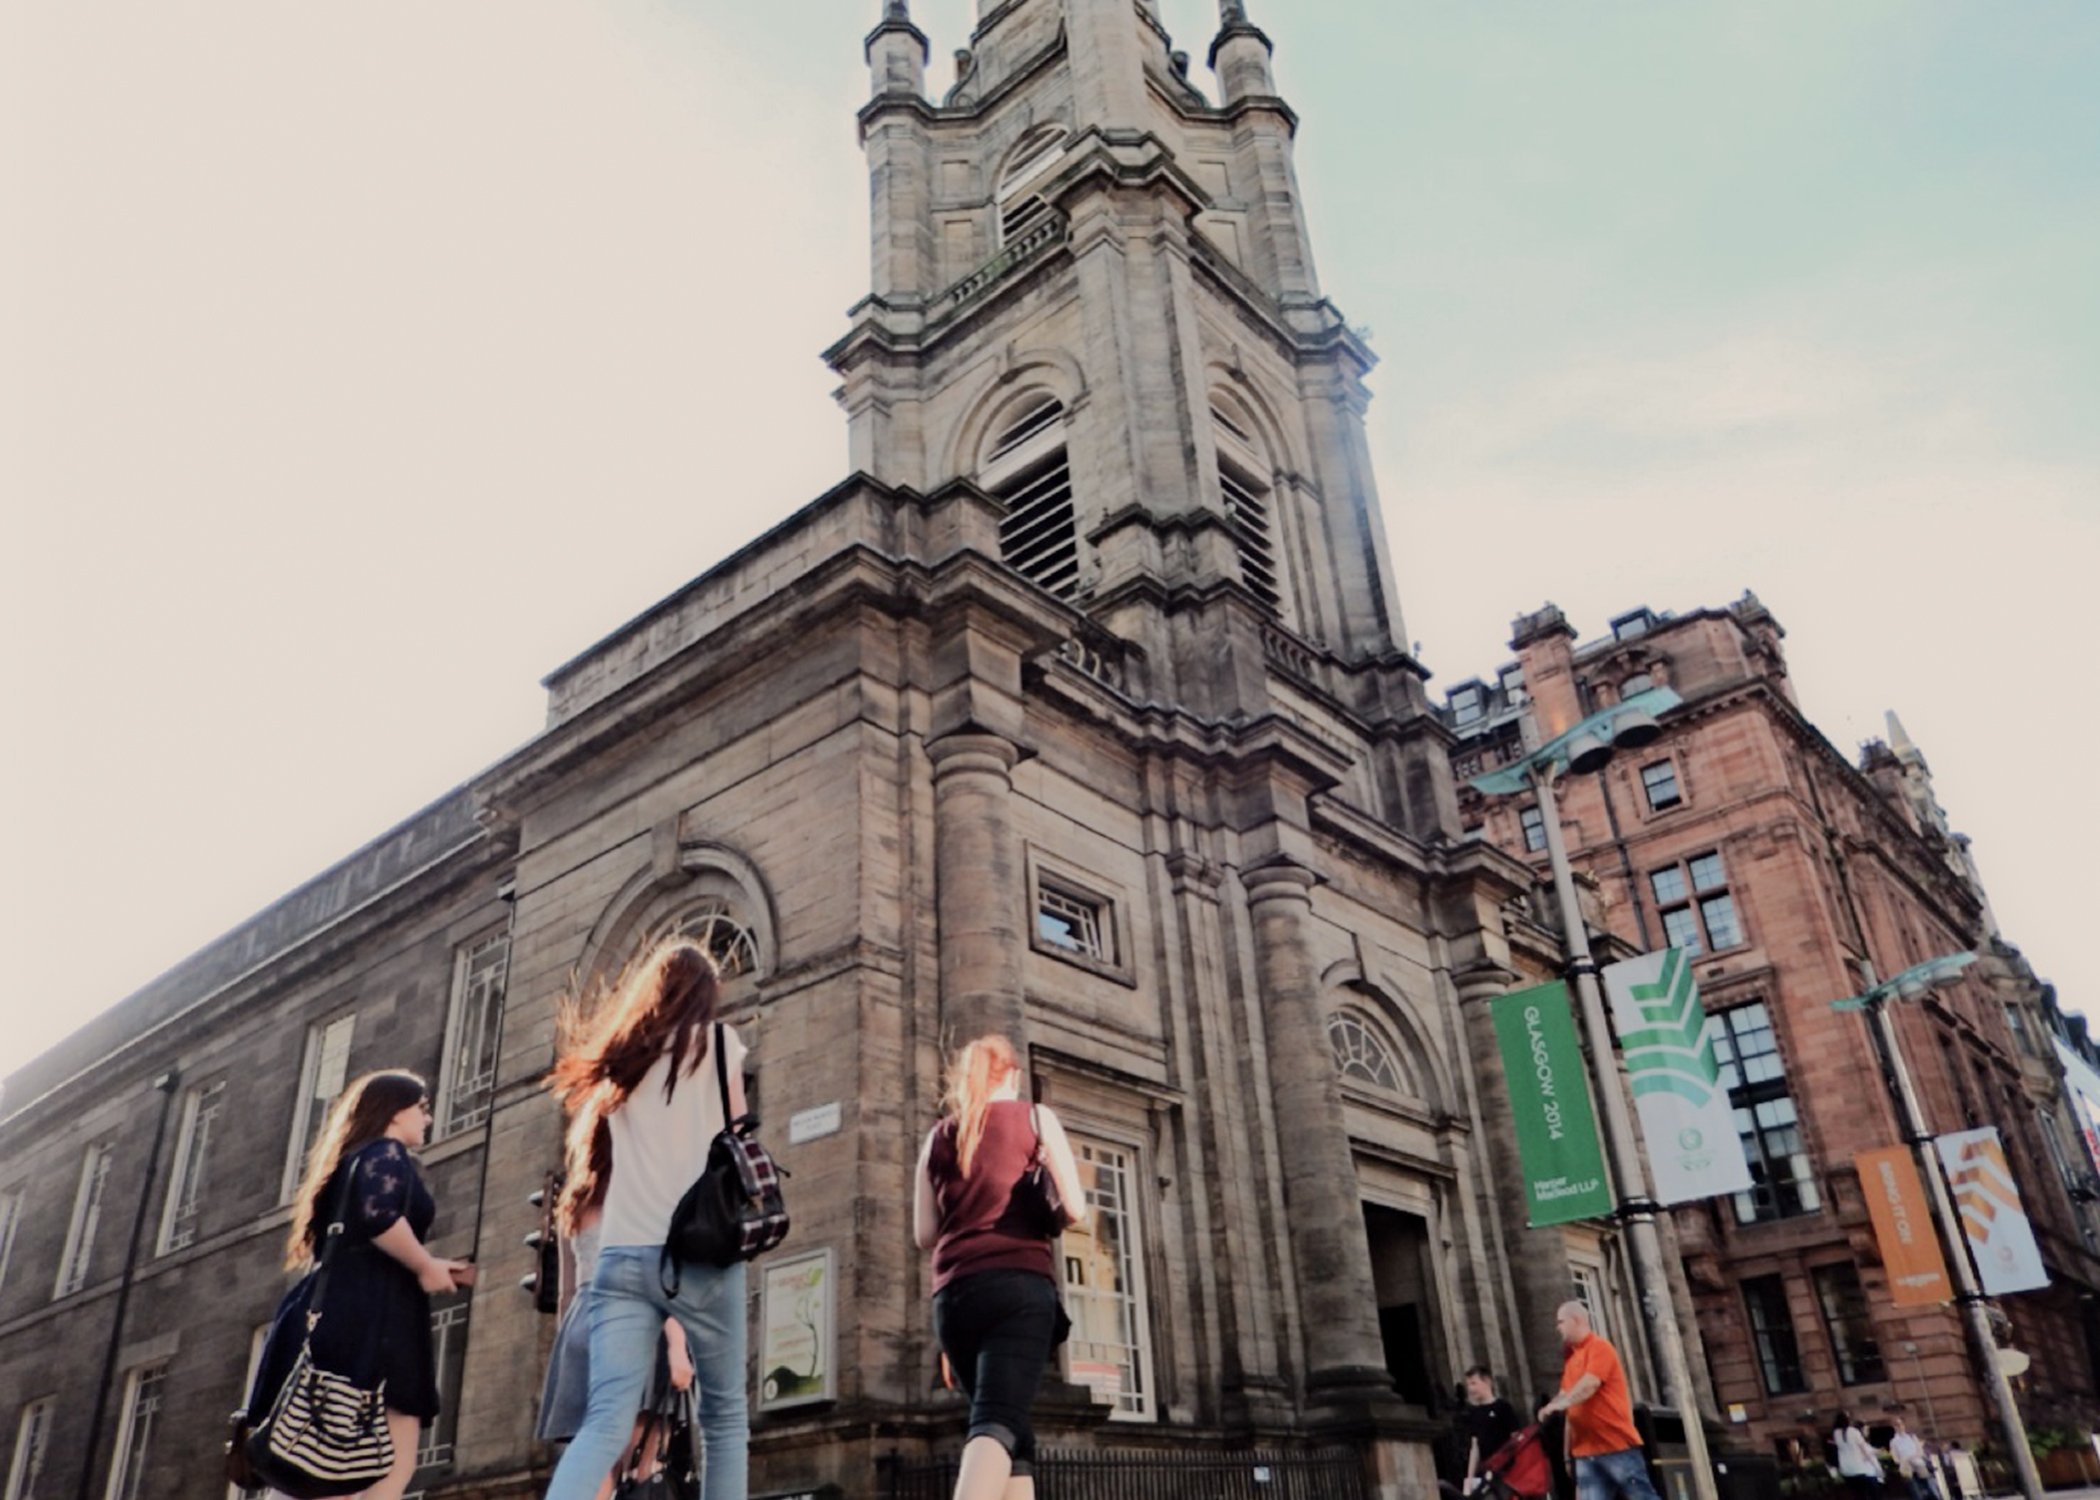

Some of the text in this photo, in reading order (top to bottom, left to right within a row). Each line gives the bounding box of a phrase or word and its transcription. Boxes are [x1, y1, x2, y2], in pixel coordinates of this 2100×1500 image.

[1524, 1006, 1563, 1140] GLASGOW 2014
[1579, 1178, 1600, 1194] LLP
[1897, 1219, 1913, 1244] ON
